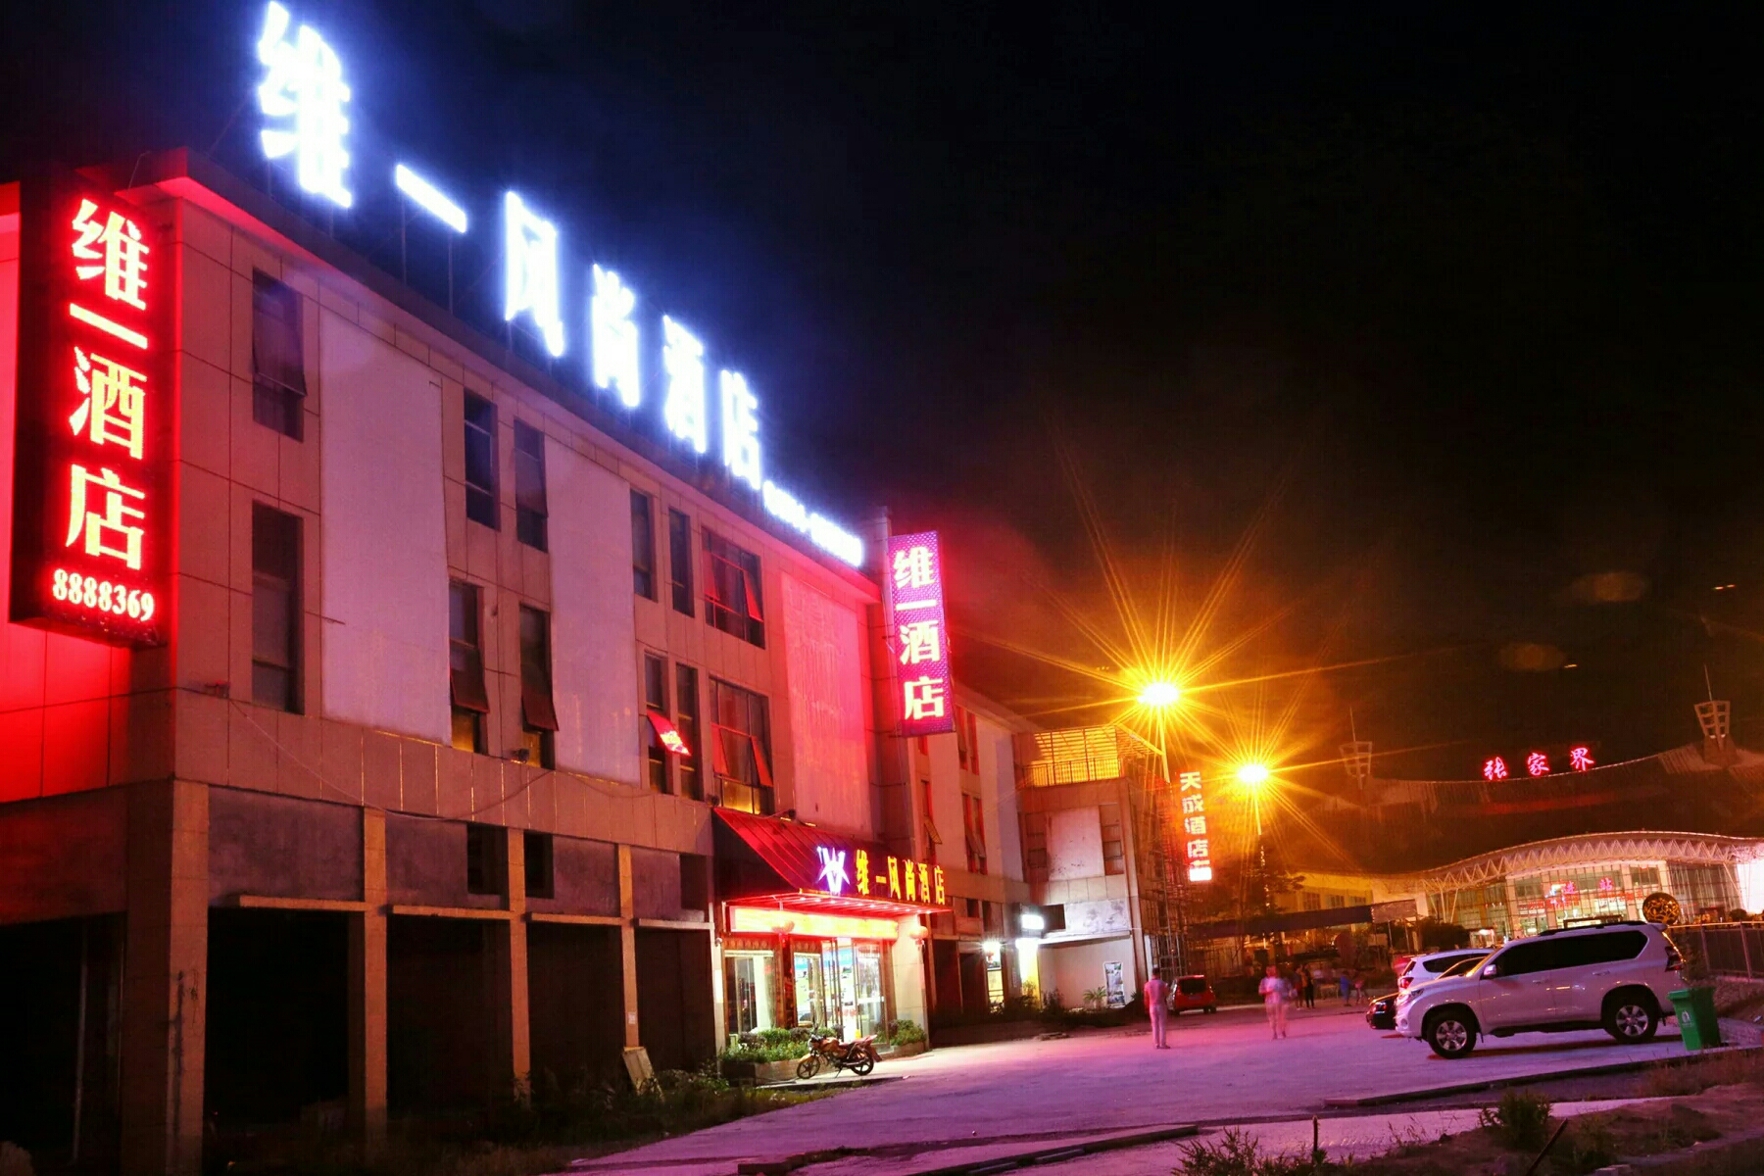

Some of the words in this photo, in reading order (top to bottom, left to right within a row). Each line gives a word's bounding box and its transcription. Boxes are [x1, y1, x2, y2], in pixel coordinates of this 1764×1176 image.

[66, 198, 150, 570] 维一酒店
[52, 568, 155, 622] 8888369
[893, 546, 944, 720] 维一酒店
[1484, 747, 1595, 781] 张家界
[1180, 771, 1208, 858] 天成酒店
[856, 849, 945, 905] 维一风尚酒店
